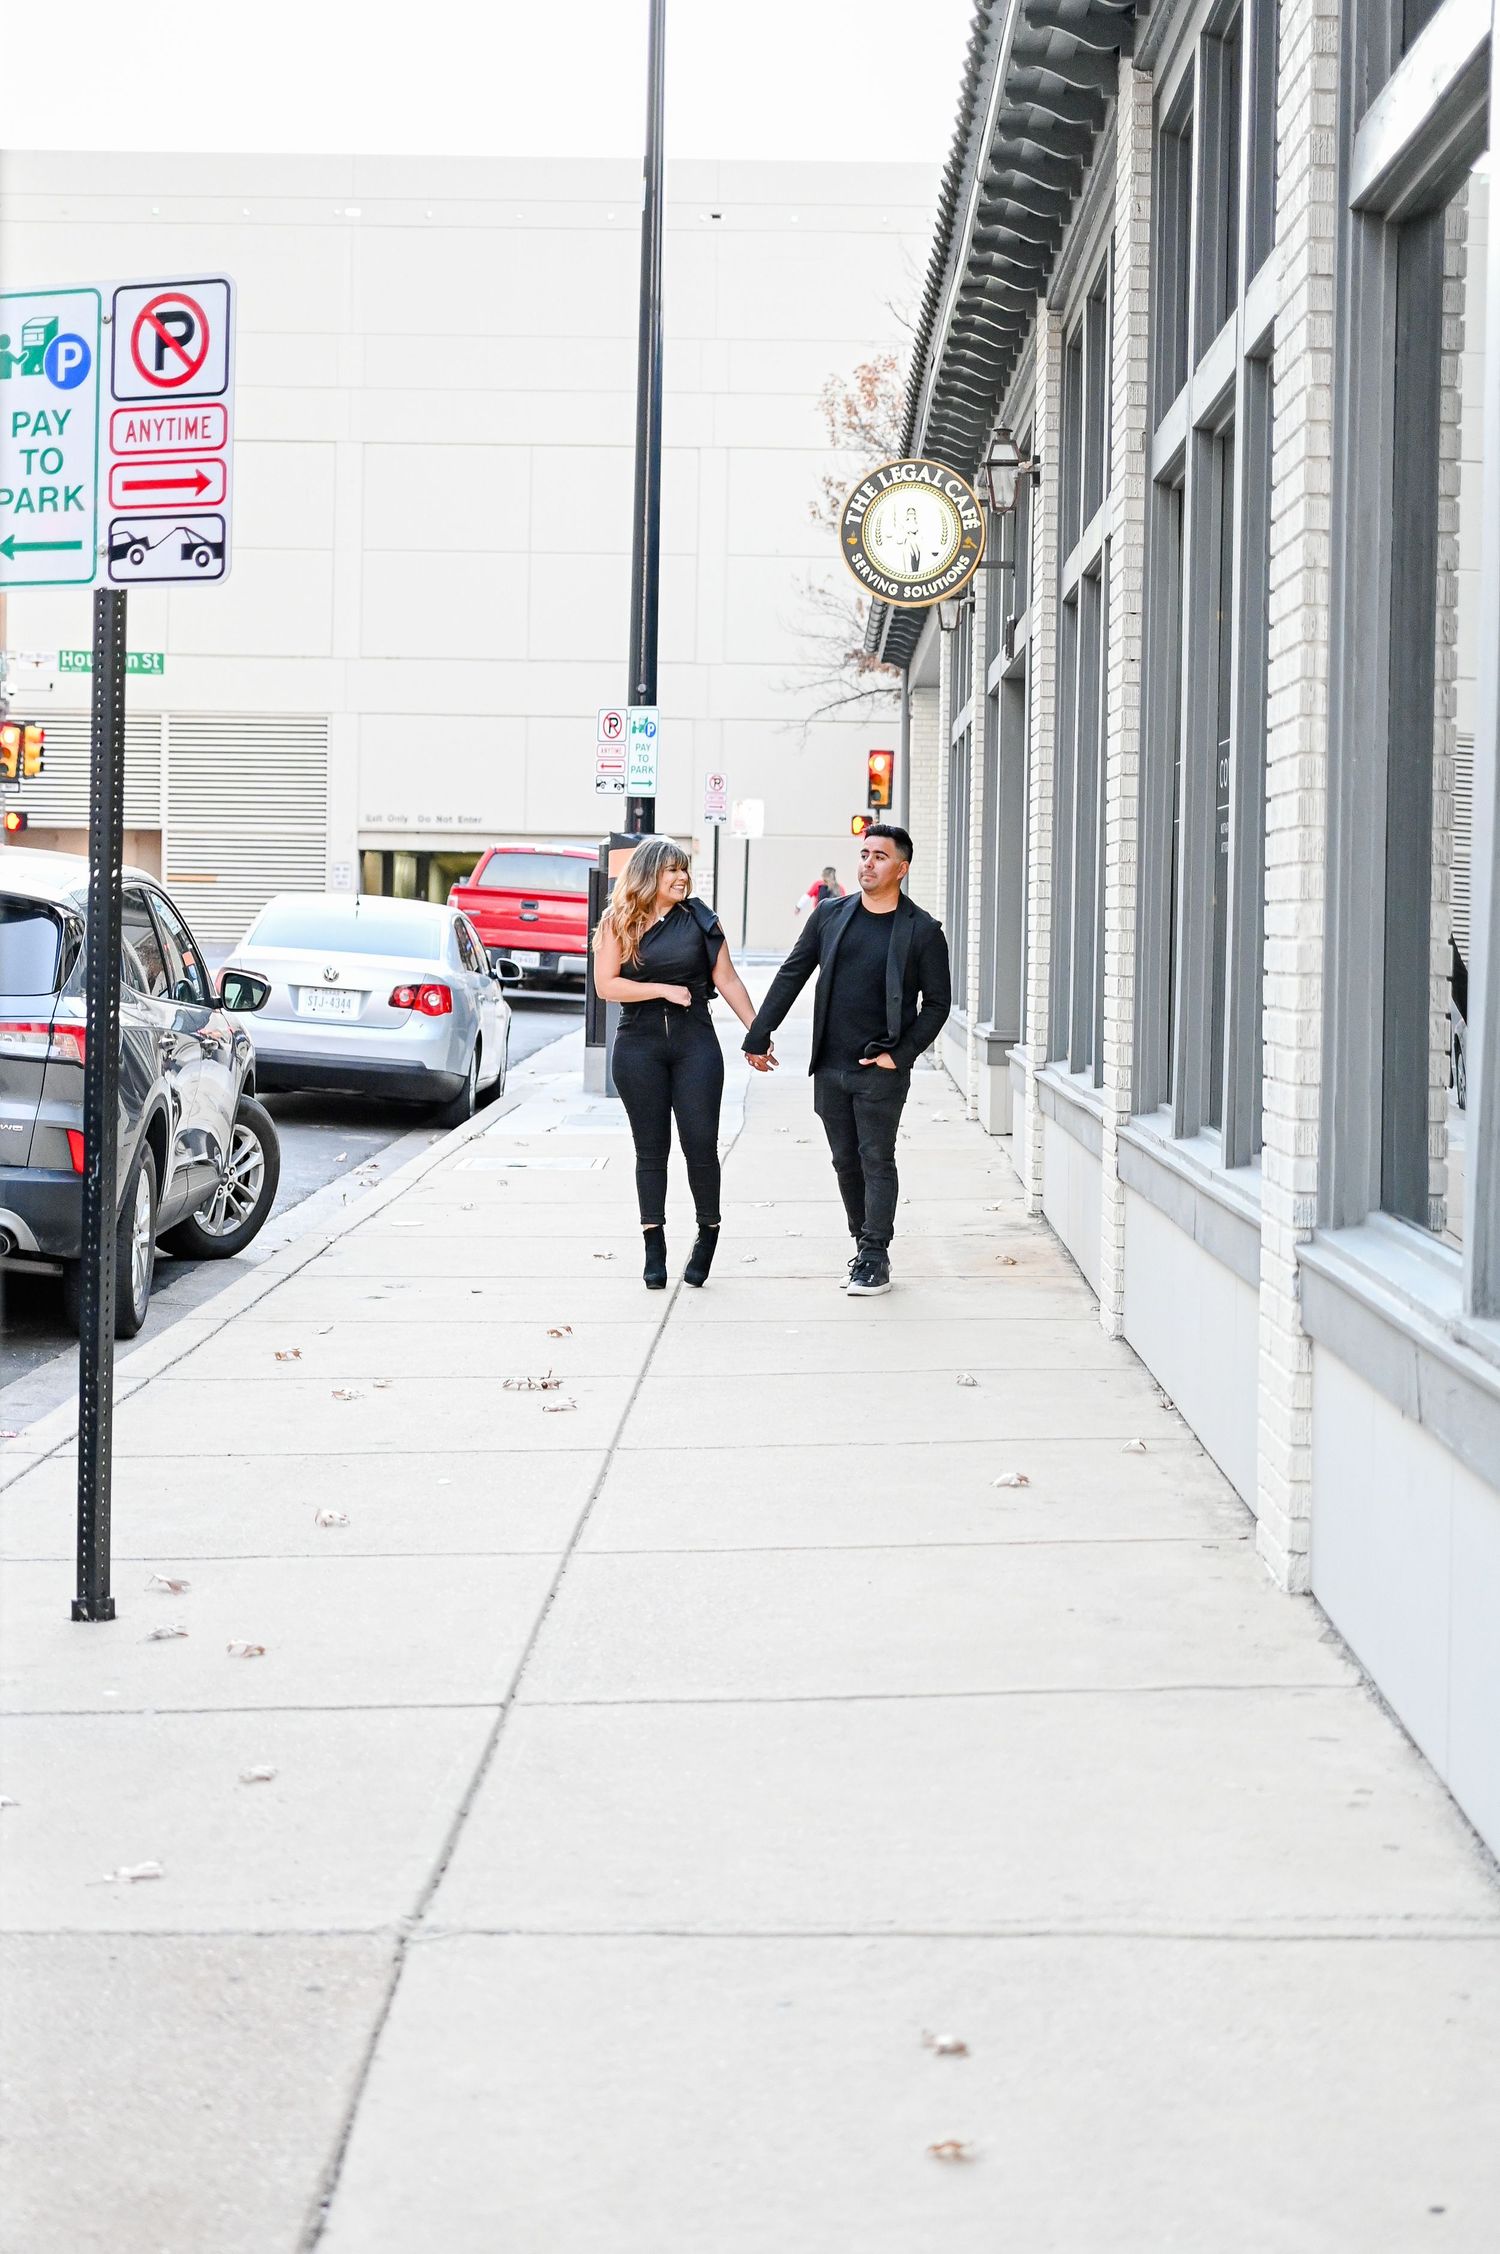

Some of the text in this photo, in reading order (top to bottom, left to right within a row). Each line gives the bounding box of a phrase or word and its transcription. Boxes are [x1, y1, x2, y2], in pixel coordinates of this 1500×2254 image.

[11, 408, 72, 438] PAY
[125, 415, 212, 443] ANYTIME
[19, 447, 64, 475] TO
[845, 481, 878, 526] THE
[877, 464, 944, 488] LEGAL
[851, 552, 970, 598] SERVING SOLUTIONS
[61, 651, 139, 669] Houn
[142, 653, 160, 669] St
[635, 743, 652, 751] PAY
[638, 754, 650, 763] TO
[630, 765, 655, 774] PARK
[387, 814, 408, 824] Only
[417, 814, 432, 823] Do
[436, 815, 453, 824] Not
[458, 815, 482, 824] Enter
